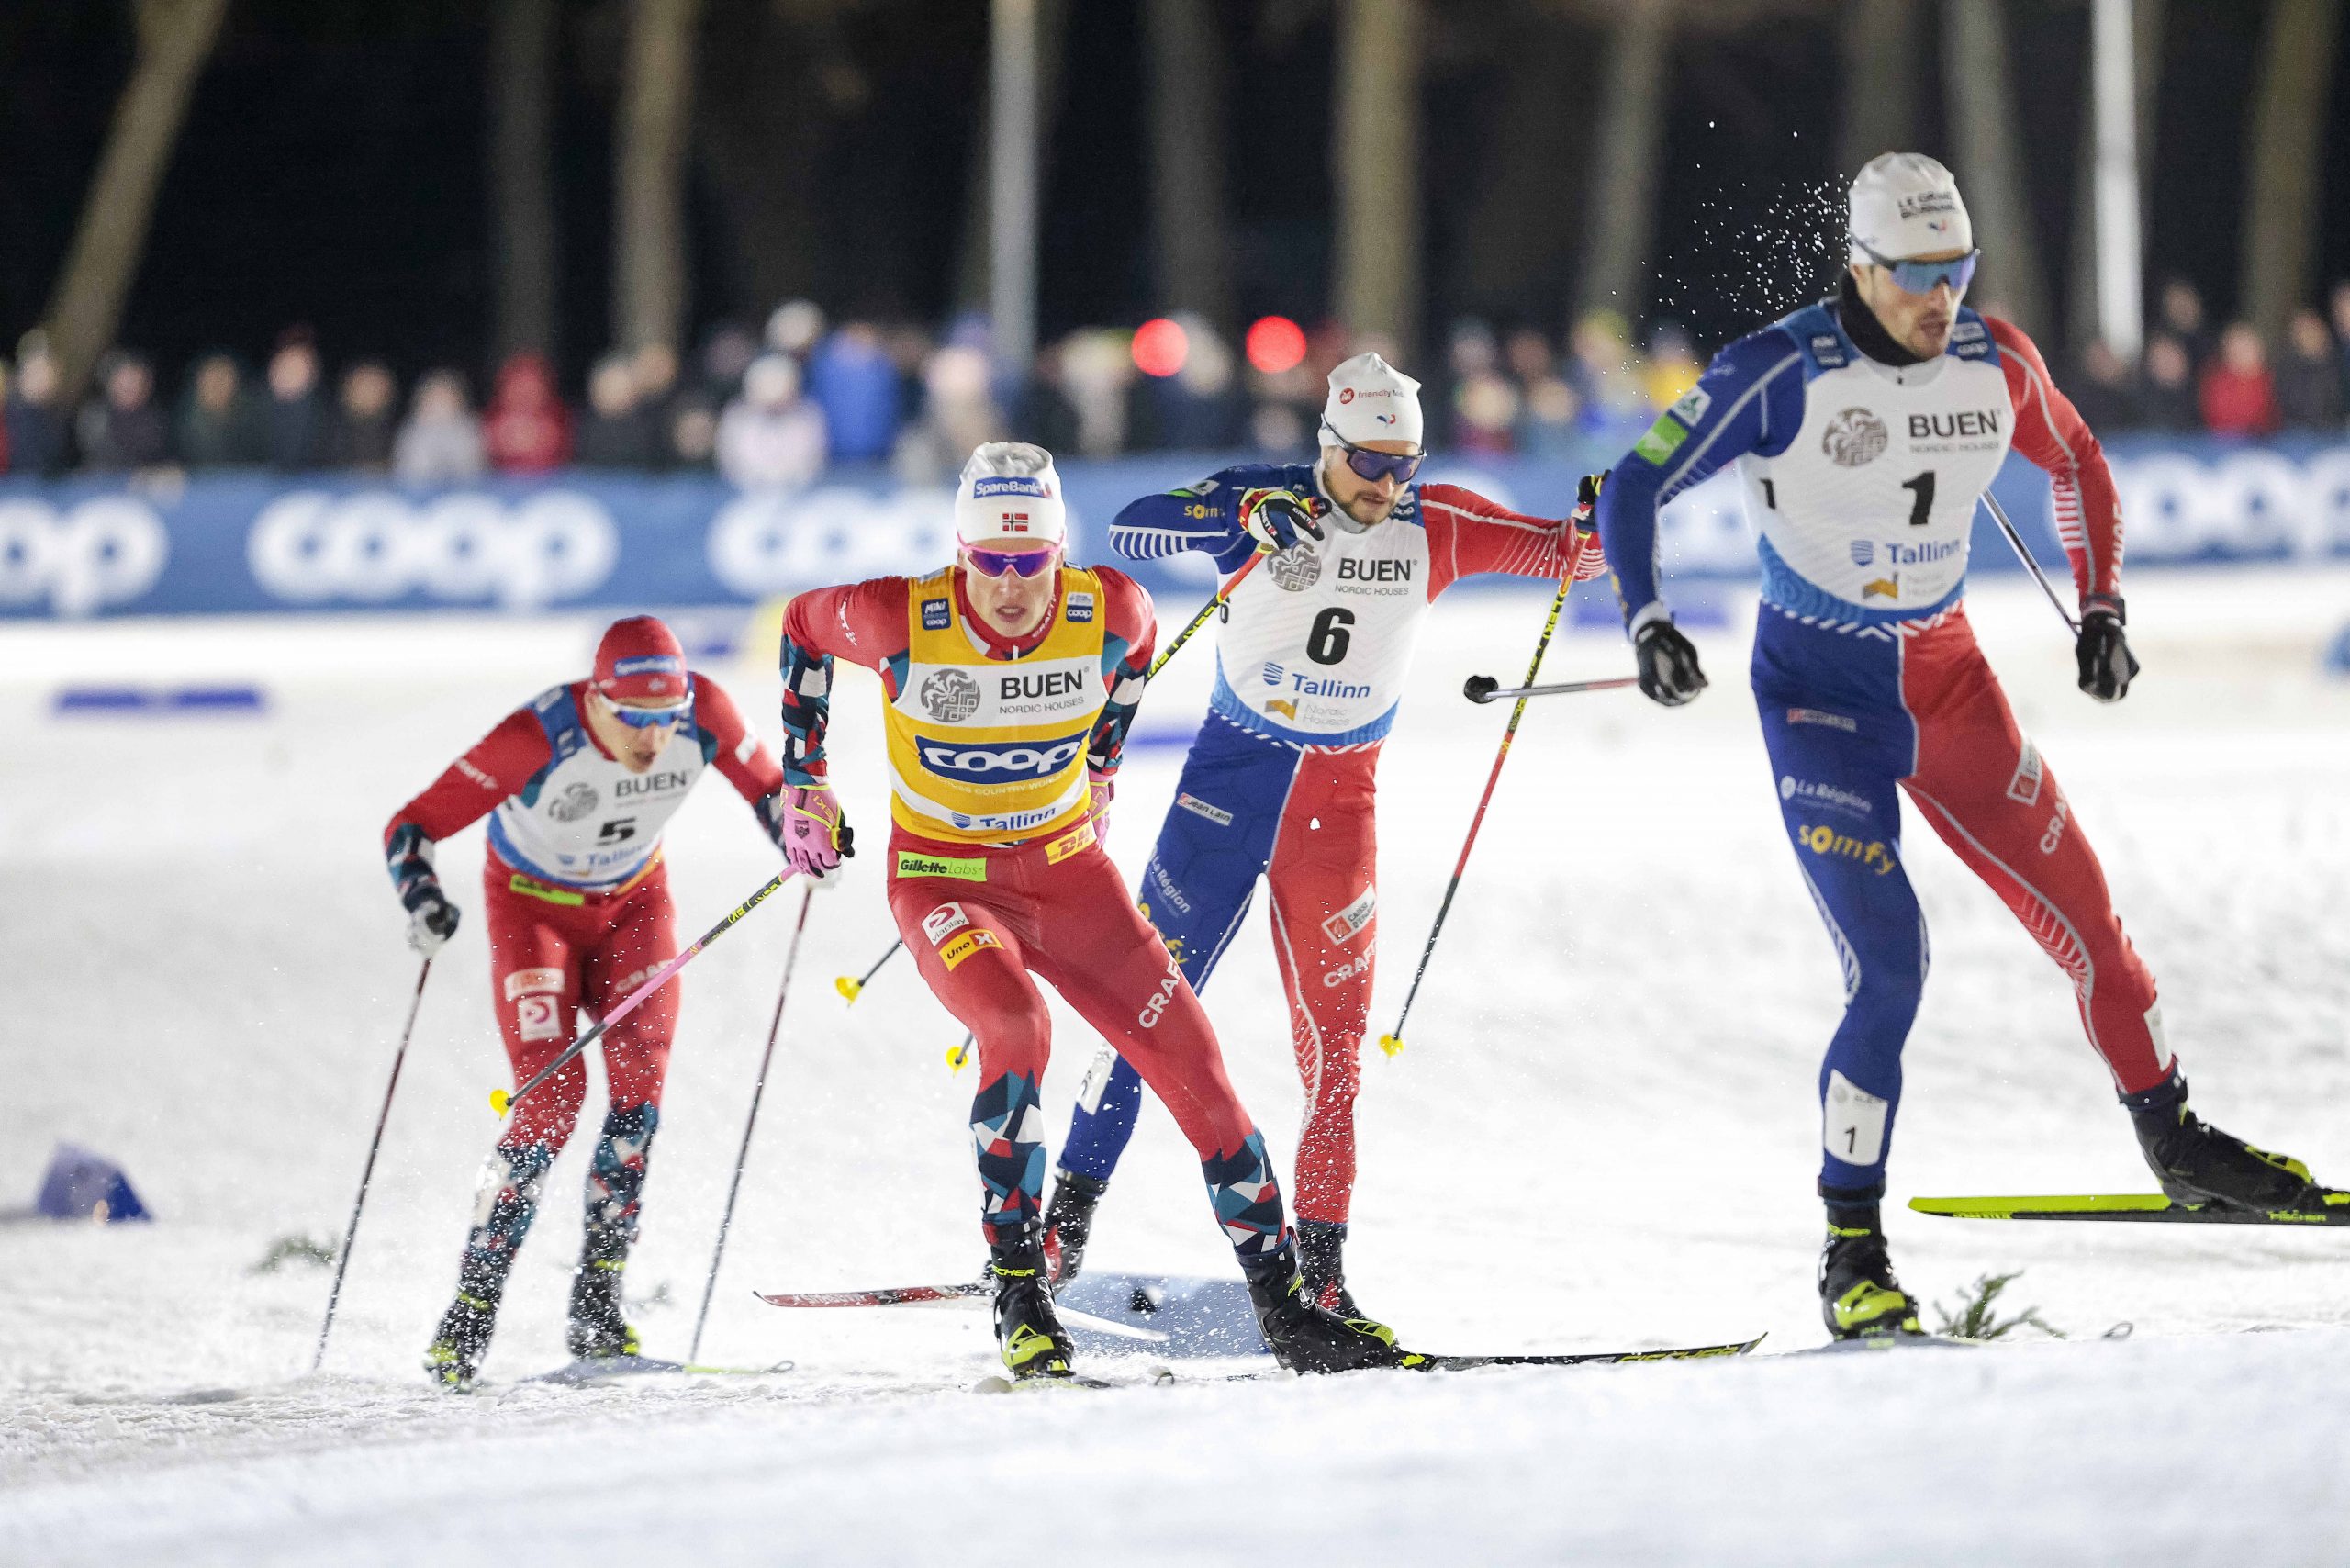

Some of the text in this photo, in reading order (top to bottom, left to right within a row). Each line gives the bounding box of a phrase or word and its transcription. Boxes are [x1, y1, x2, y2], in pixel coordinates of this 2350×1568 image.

[1908, 409, 1998, 438] BUEN
[976, 480, 1039, 497] SpareBank
[1759, 476, 1777, 510] 1
[1901, 469, 1936, 527] 1
[246, 491, 620, 613] coop
[1337, 557, 1411, 582] BUEN
[1334, 584, 1410, 597] NORDIC HOUSES
[1067, 609, 1093, 619] coop
[1305, 606, 1356, 666] 6
[1000, 669, 1083, 700] BUEN
[1292, 672, 1371, 699] Tallinn
[999, 696, 1085, 715] NORDIC HOUSES
[1302, 713, 1350, 726] Houses
[1305, 702, 1348, 716] Nordic
[923, 741, 1080, 774] coop
[615, 770, 688, 798] BUEN
[974, 784, 1027, 797] COUNTRY
[596, 816, 636, 846] 5
[979, 807, 1057, 831] Tallinn
[1057, 827, 1091, 857] DH
[1798, 824, 1896, 876] somfy
[1158, 869, 1192, 913] Région
[931, 917, 966, 942] viaplay
[946, 941, 970, 959] Uno
[1138, 957, 1181, 1028] CRAF
[1844, 1126, 1856, 1154] 1
